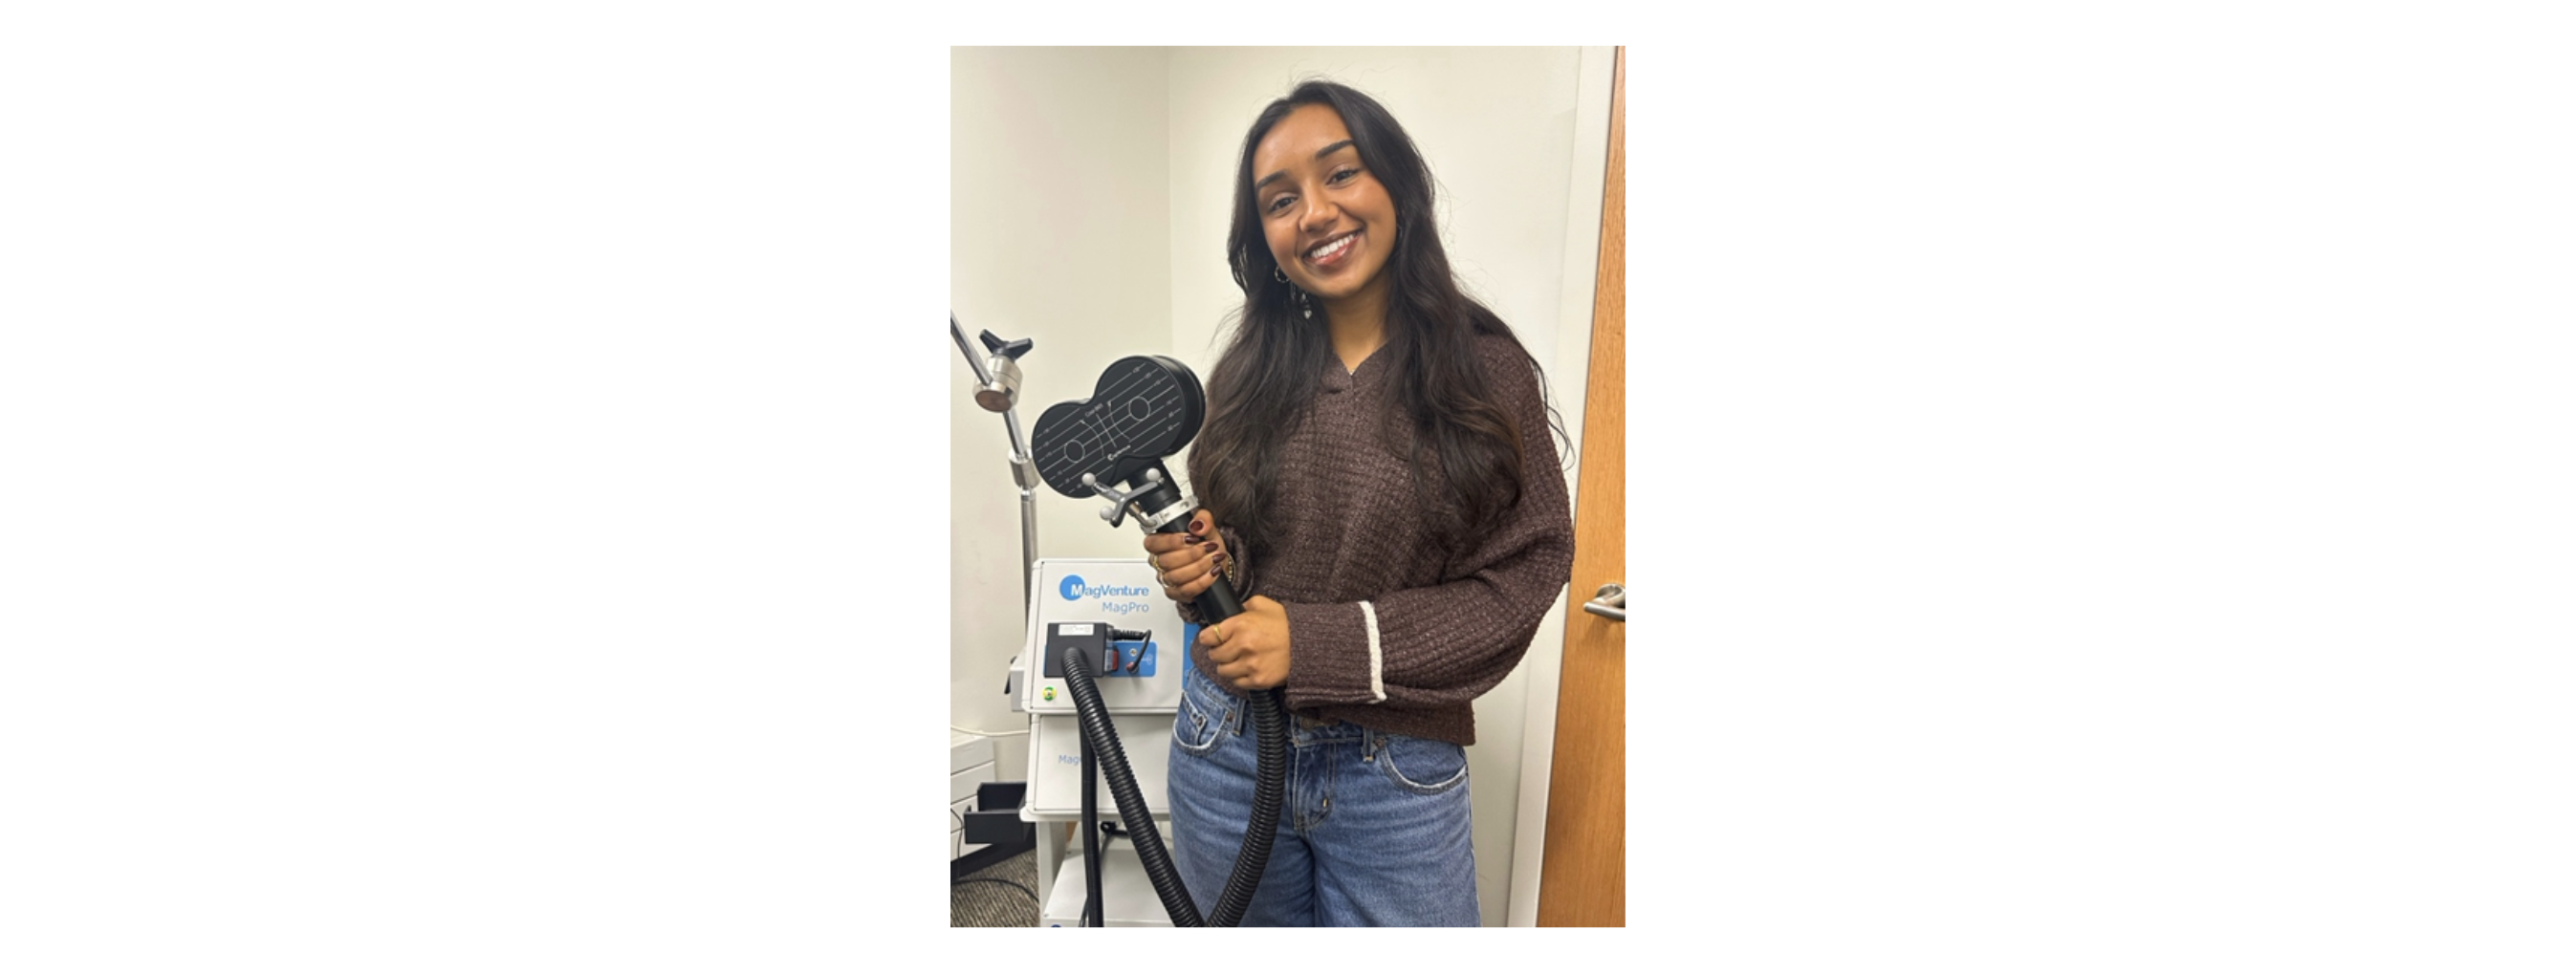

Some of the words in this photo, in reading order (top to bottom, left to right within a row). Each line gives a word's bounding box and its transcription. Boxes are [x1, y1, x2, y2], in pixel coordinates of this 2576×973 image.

[1070, 583, 1149, 599] MagVenture
[1102, 601, 1150, 615] MagPro
[1058, 754, 1081, 766] Mag
